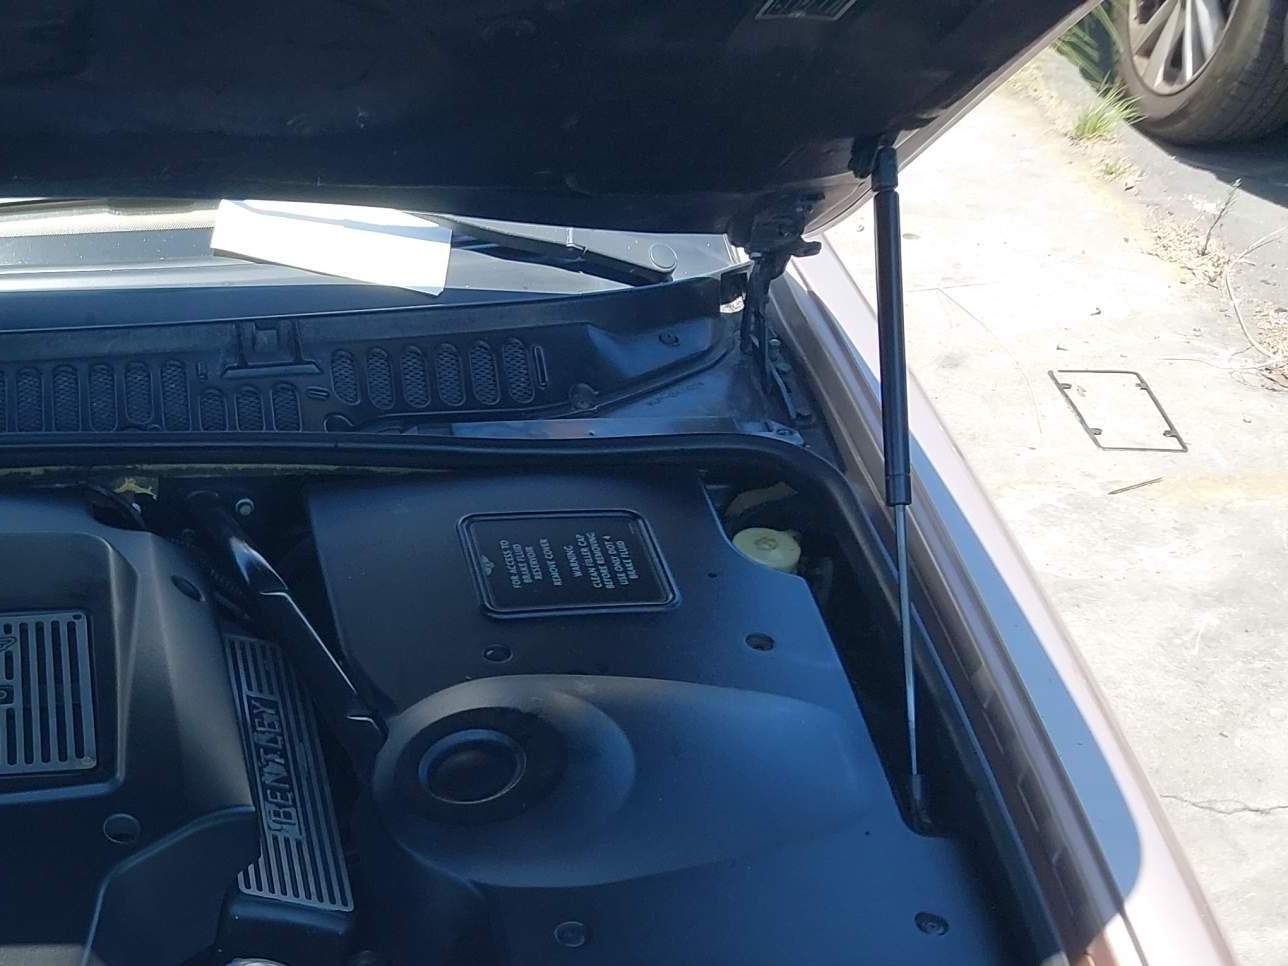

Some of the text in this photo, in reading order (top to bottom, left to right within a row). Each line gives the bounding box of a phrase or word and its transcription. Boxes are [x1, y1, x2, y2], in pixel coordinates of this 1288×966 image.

[500, 540, 522, 589] FOR ACCESS TO
[525, 546, 543, 580] RESERVOIR
[540, 539, 562, 586] REMOVE COVER
[564, 545, 583, 577] WARNING
[576, 534, 603, 588] CLEAN FILLER CAP
[586, 532, 616, 589] BEFORE REMOVING
[604, 542, 617, 554] DOT
[611, 556, 624, 572] ONLY
[518, 563, 533, 583] BRAKE
[616, 573, 629, 585] USE
[623, 560, 639, 579] BRAKE
[252, 700, 296, 831] BENTLEY
